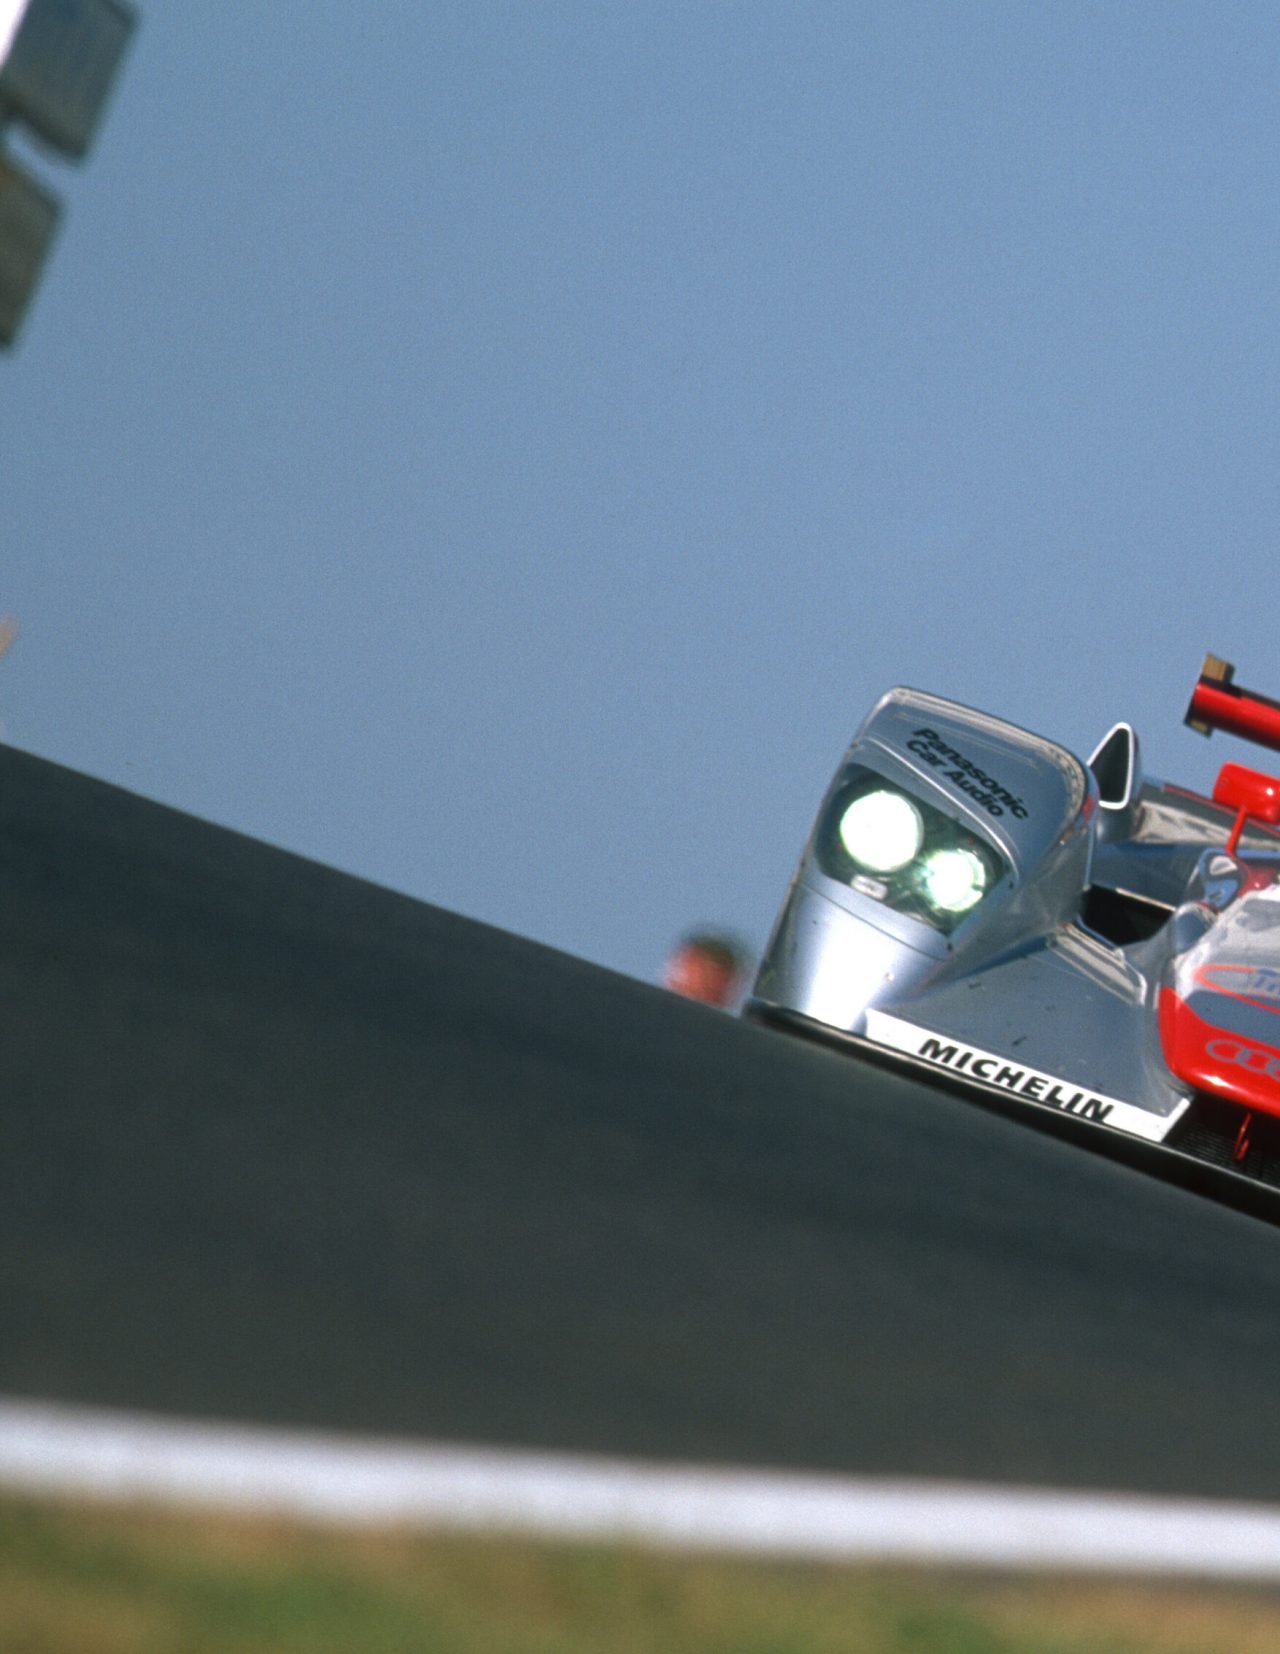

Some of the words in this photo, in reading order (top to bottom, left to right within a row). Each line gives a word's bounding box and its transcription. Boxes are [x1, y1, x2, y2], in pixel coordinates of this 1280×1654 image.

[906, 740, 947, 767] Car
[943, 771, 1004, 817] Audio
[912, 728, 1029, 819] Panasonic
[918, 1038, 1115, 1123] MICHELIN
